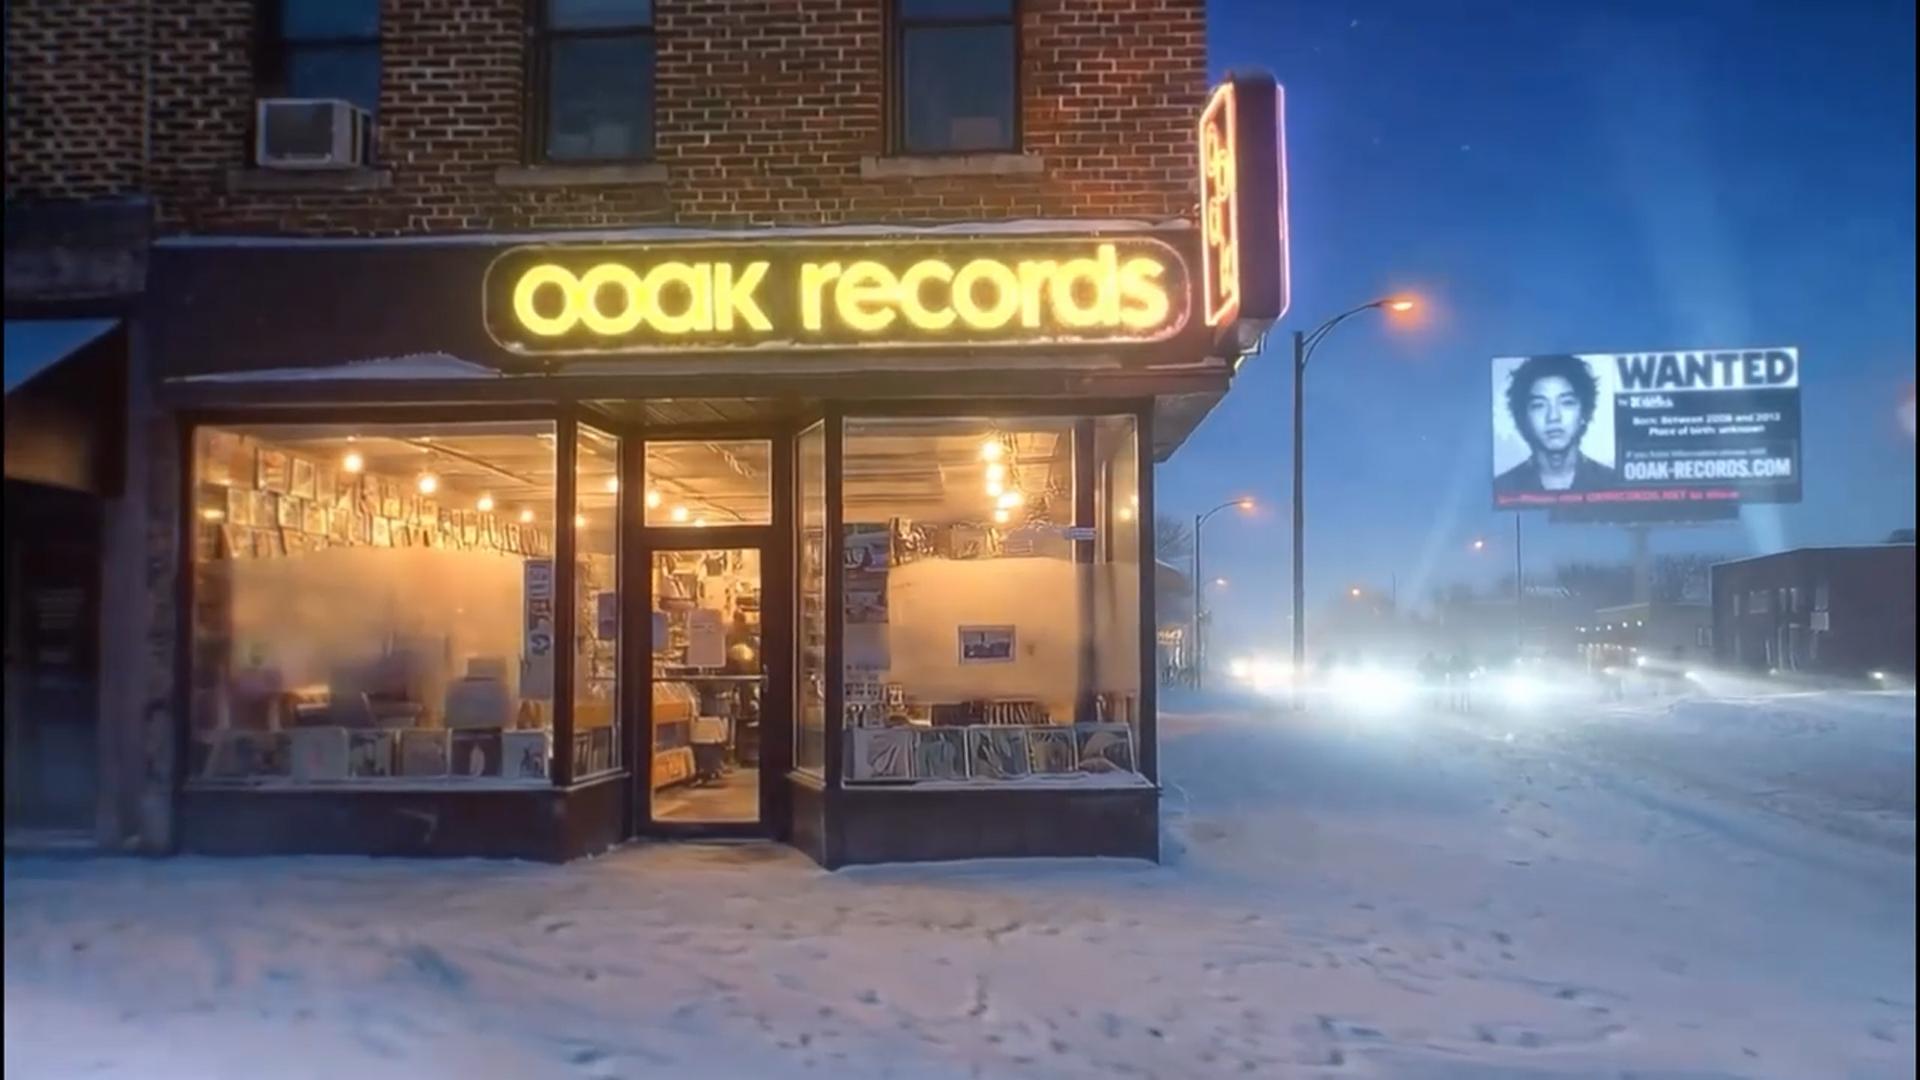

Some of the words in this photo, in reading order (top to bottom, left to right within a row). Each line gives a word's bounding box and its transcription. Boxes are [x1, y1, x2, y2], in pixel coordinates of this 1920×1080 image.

[513, 259, 773, 336] ooak
[800, 244, 1169, 332] records
[1616, 351, 1795, 390] WANTED
[1624, 457, 1792, 481] OOAK-RECORDS.COM
